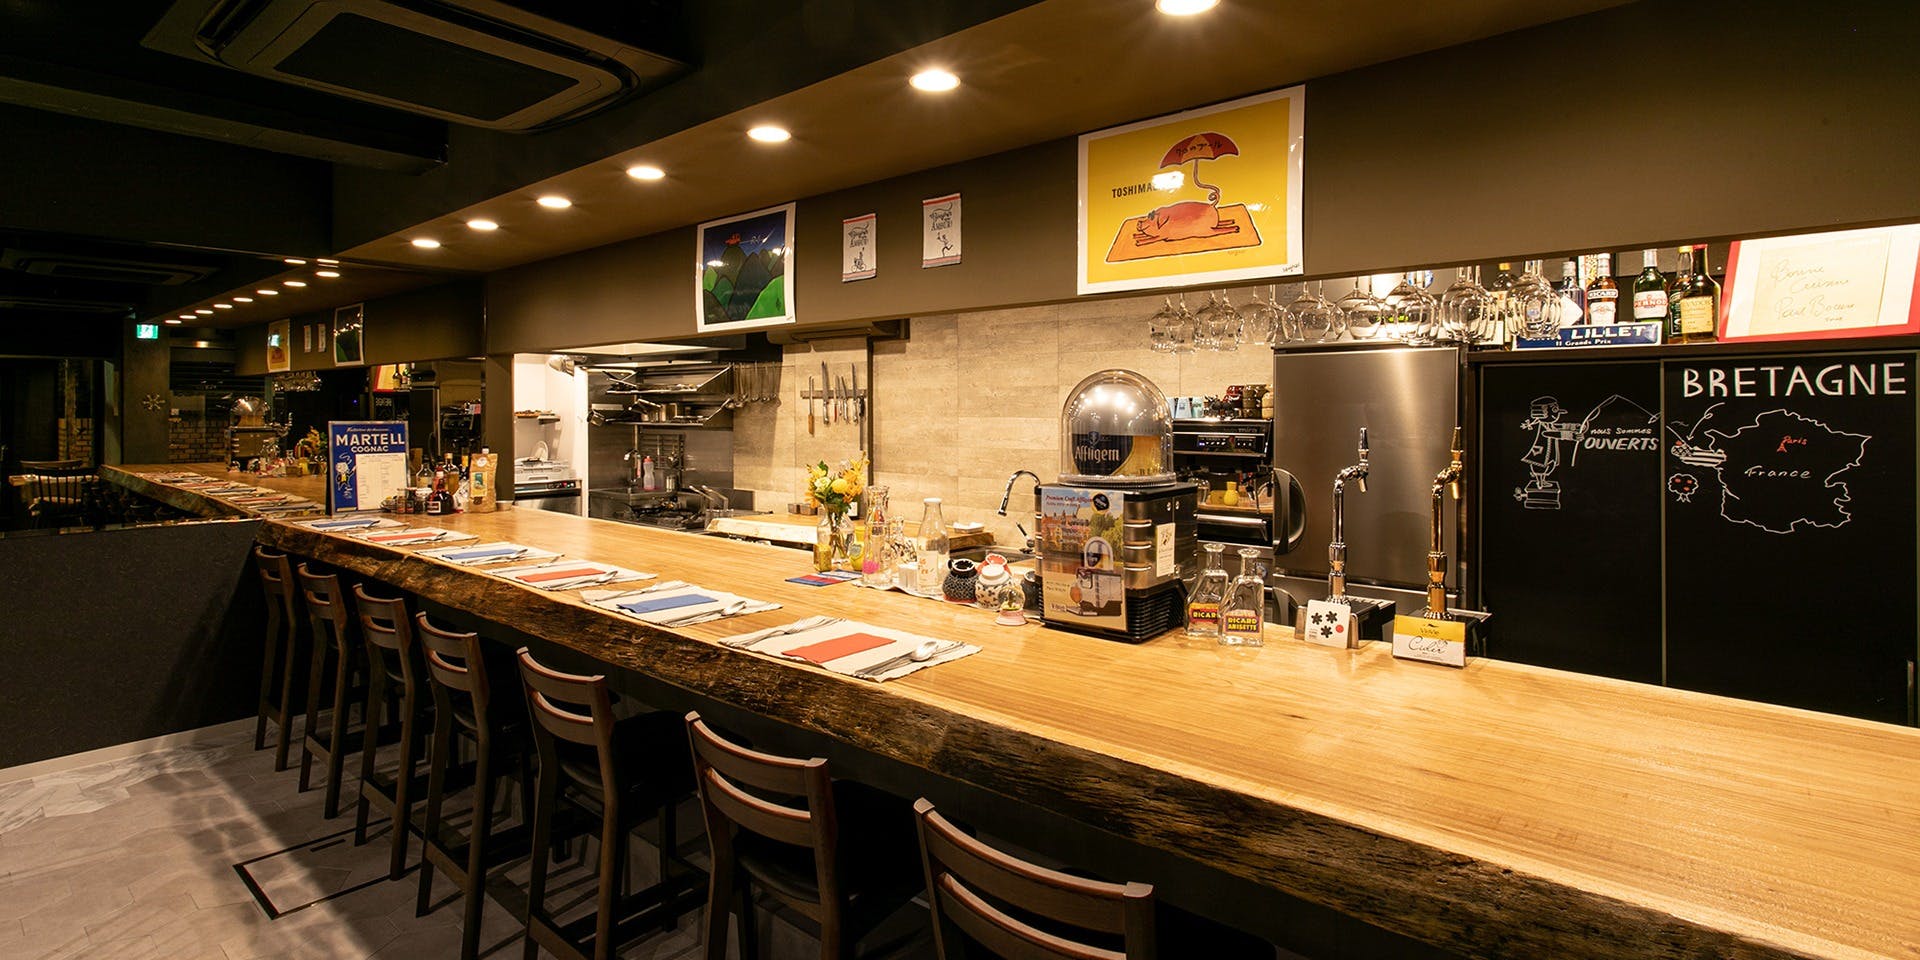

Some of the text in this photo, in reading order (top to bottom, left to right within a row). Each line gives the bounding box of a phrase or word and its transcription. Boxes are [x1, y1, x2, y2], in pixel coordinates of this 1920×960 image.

[1112, 181, 1161, 199] TOSHIMA
[1571, 325, 1646, 340] LILLET
[1565, 339, 1592, 347] Grands
[1683, 362, 1907, 398] BRETAGNE
[1590, 427, 1612, 435] nous
[336, 433, 405, 446] MARTELL
[1583, 436, 1660, 451] OUVERTS
[1783, 435, 1808, 447] Paris
[350, 445, 389, 453] COGNAC
[1074, 443, 1120, 464] Affligem
[1744, 465, 1812, 479] France
[1408, 635, 1446, 655] Cider
